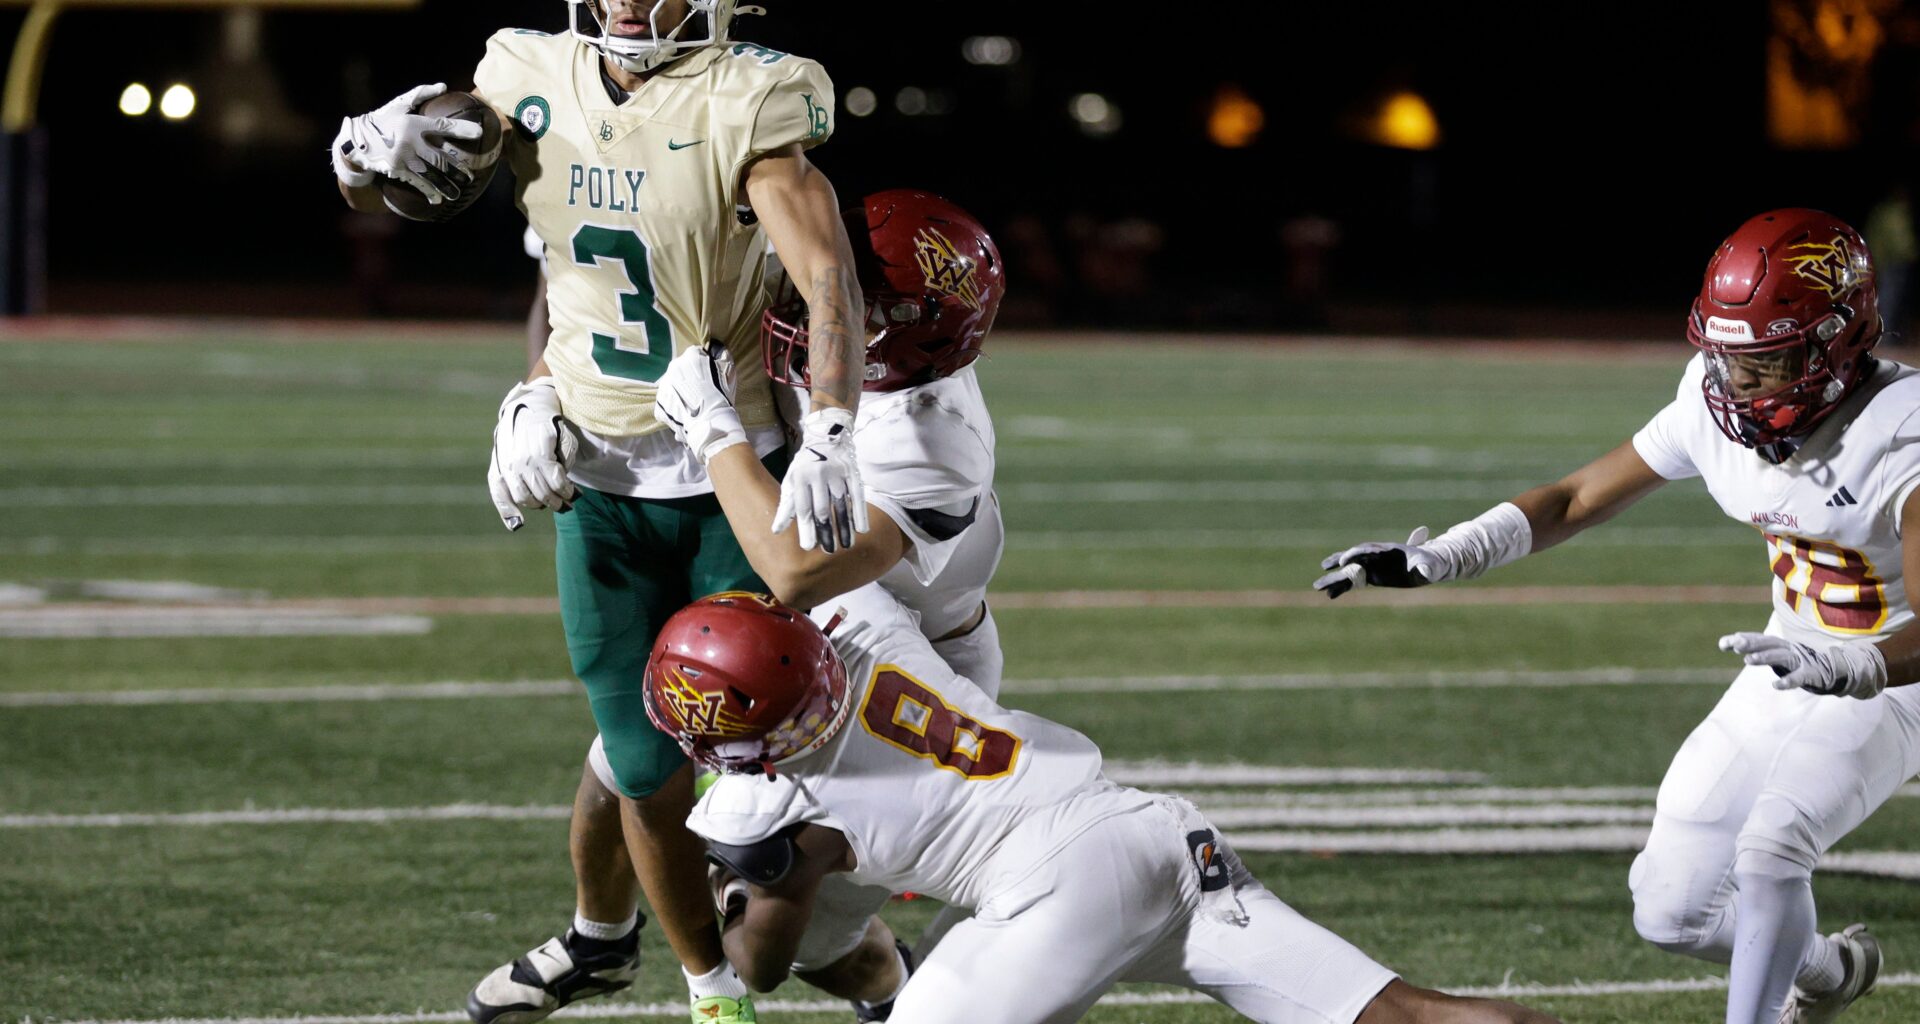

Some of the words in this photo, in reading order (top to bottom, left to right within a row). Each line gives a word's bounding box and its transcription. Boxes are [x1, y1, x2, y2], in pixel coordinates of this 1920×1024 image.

[599, 118, 615, 142] LB
[567, 162, 647, 213] POLY
[569, 222, 678, 388] 3
[1709, 320, 1746, 335] Riddell
[1750, 511, 1799, 529] WILSON
[858, 663, 1023, 781] 8
